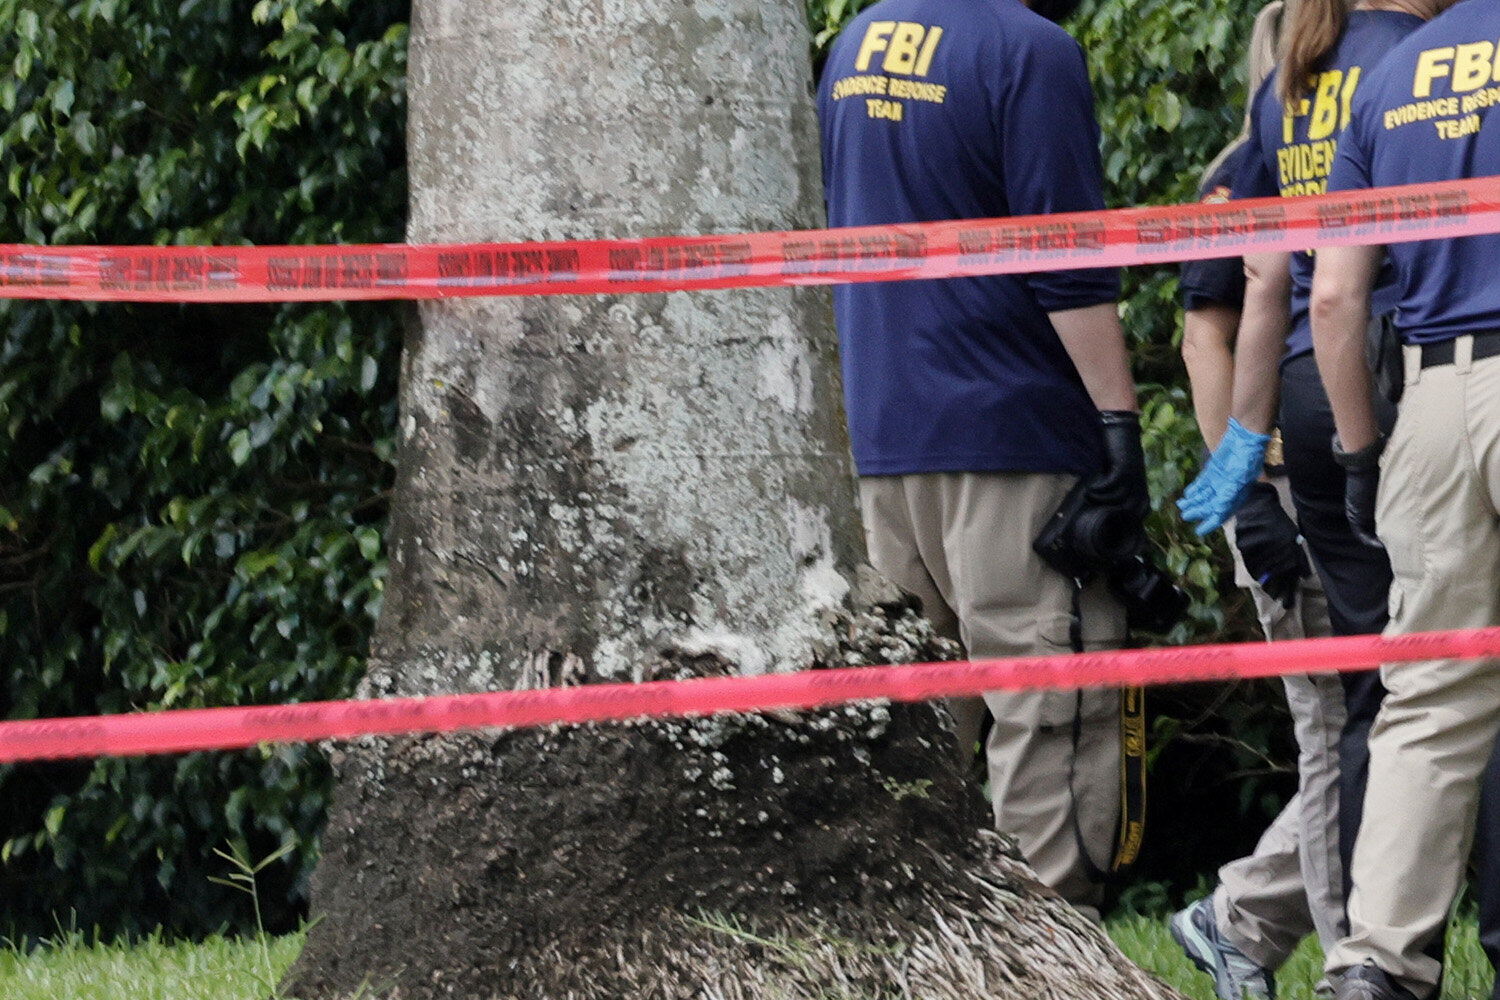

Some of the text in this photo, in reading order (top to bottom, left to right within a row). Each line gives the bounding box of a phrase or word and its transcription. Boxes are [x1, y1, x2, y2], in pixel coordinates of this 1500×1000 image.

[855, 20, 944, 77] FBI
[888, 77, 947, 104] REPONSE
[865, 99, 903, 122] TEAM
[1383, 97, 1460, 131] EVIDENCE
[1435, 114, 1481, 140] TEAM
[1276, 139, 1338, 185] EVIDEN
